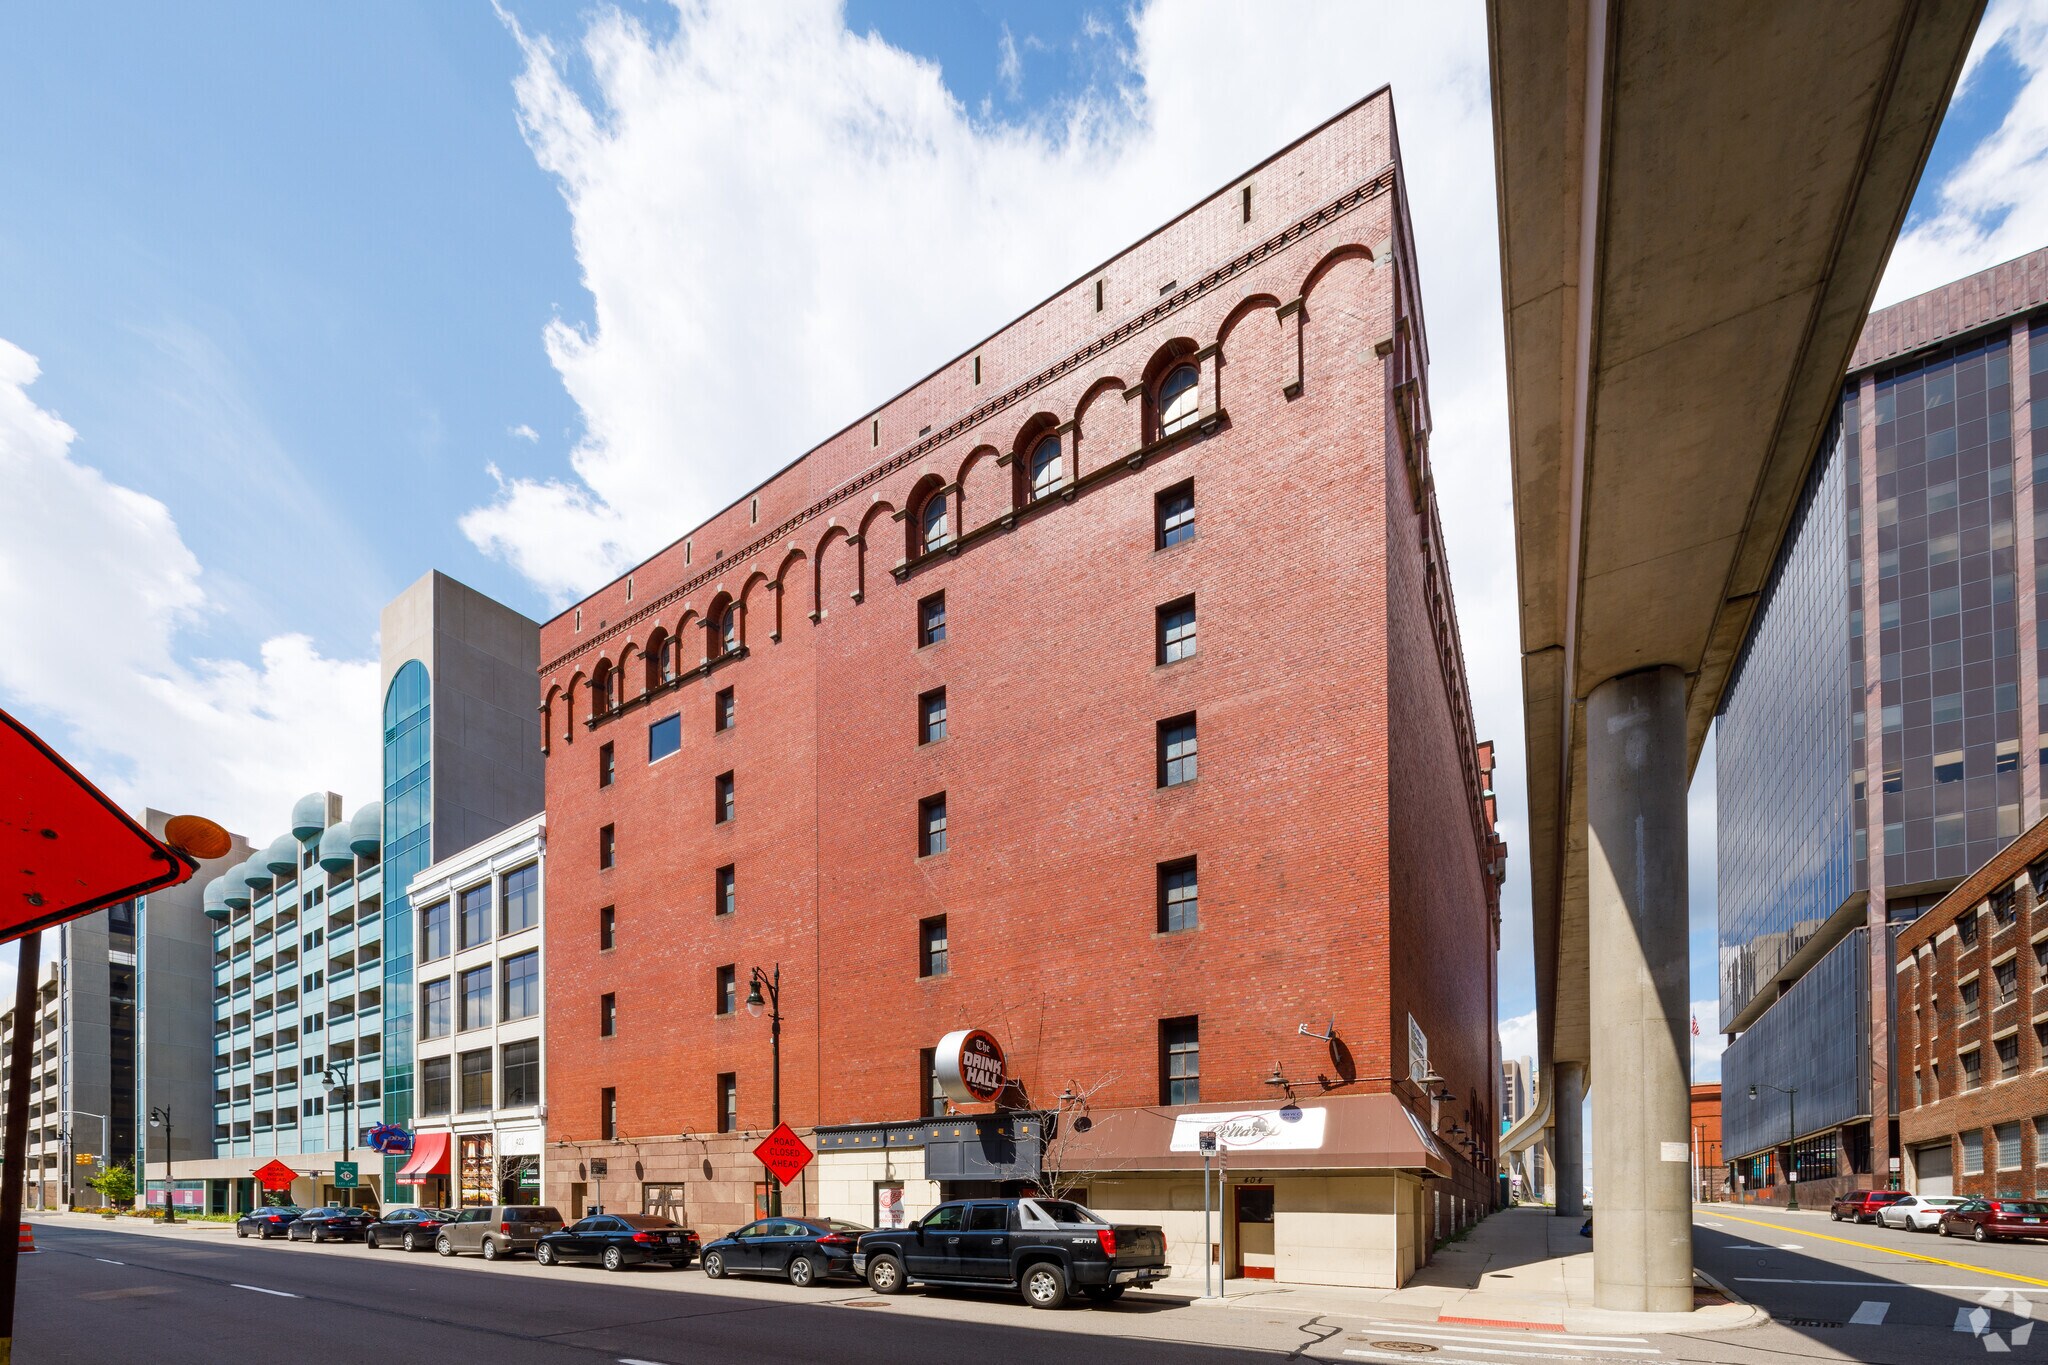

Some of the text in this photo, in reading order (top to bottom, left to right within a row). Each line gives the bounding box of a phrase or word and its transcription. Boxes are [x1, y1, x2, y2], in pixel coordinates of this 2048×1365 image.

[976, 1039, 991, 1053] The
[963, 1050, 1002, 1076] DRINK
[966, 1066, 999, 1089] HALL
[774, 1137, 796, 1147] ROAD
[769, 1147, 801, 1158] CLOSED
[771, 1159, 799, 1168] AHEAD
[1244, 1176, 1263, 1184] 404
